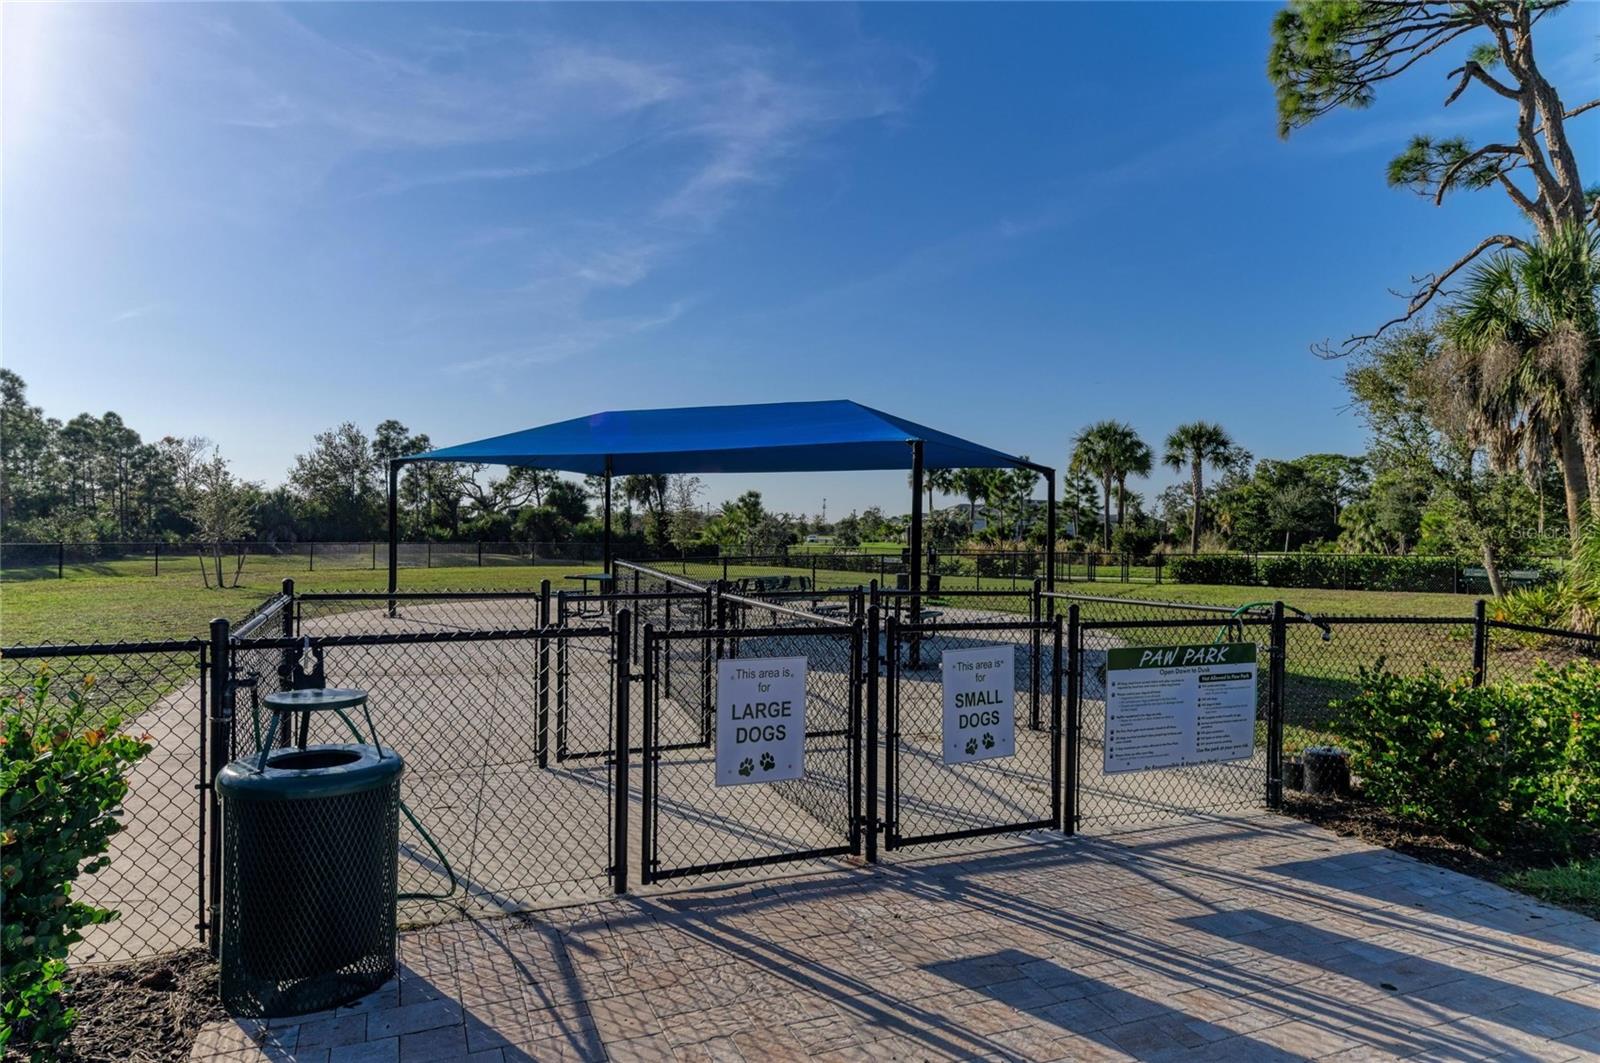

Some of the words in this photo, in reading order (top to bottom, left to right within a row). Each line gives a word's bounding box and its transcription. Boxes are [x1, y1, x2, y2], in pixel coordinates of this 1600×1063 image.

[1139, 646, 1179, 667] PAW
[1182, 645, 1230, 666] PARK
[735, 668, 756, 680] This
[758, 669, 780, 679] area
[782, 667, 790, 678] is
[957, 662, 974, 672] This
[975, 661, 992, 671] area
[994, 659, 1001, 669] is
[1159, 668, 1174, 676] Open
[975, 671, 987, 683] for
[757, 681, 771, 693] for
[954, 689, 1003, 709] SMALL
[731, 700, 792, 721] LARGE
[958, 710, 1000, 730] DOGS
[735, 724, 786, 744] DOGS
